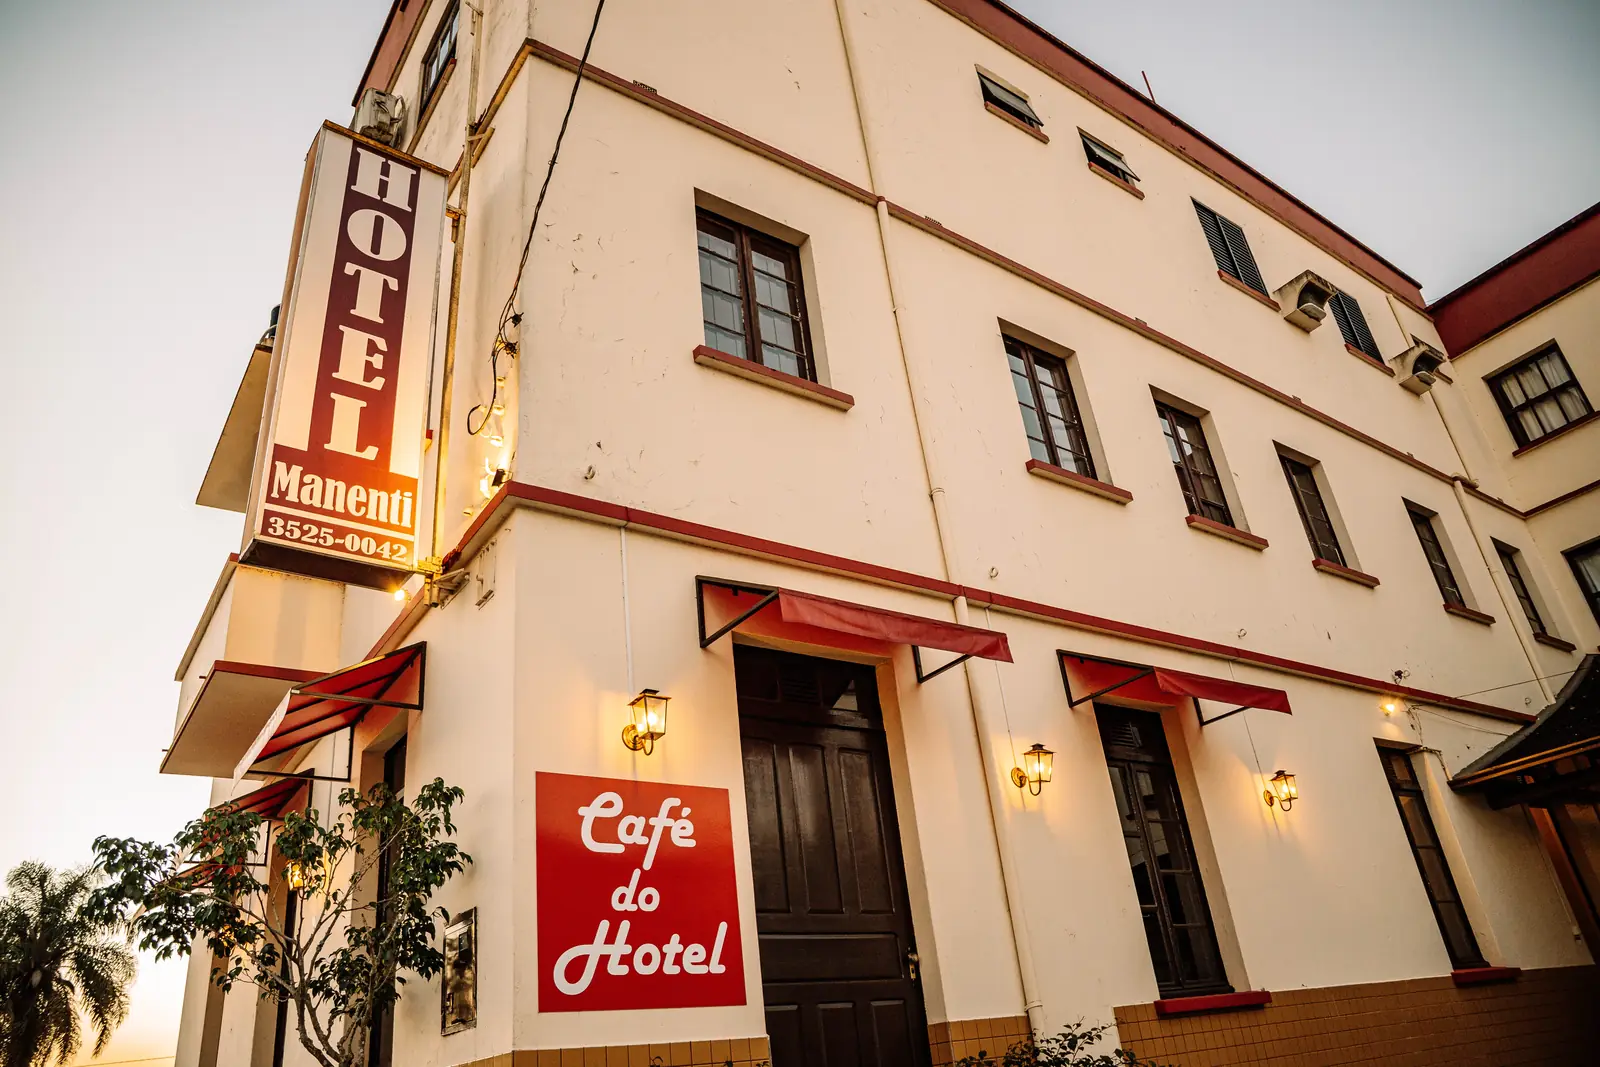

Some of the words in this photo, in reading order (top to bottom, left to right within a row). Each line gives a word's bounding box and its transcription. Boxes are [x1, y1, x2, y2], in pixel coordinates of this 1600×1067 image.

[324, 147, 417, 461] HOTEL
[270, 460, 413, 528] Manenti
[267, 516, 408, 561] 3525-0042
[577, 791, 697, 871] Café
[611, 868, 660, 912] do
[553, 919, 728, 996] Hotel
